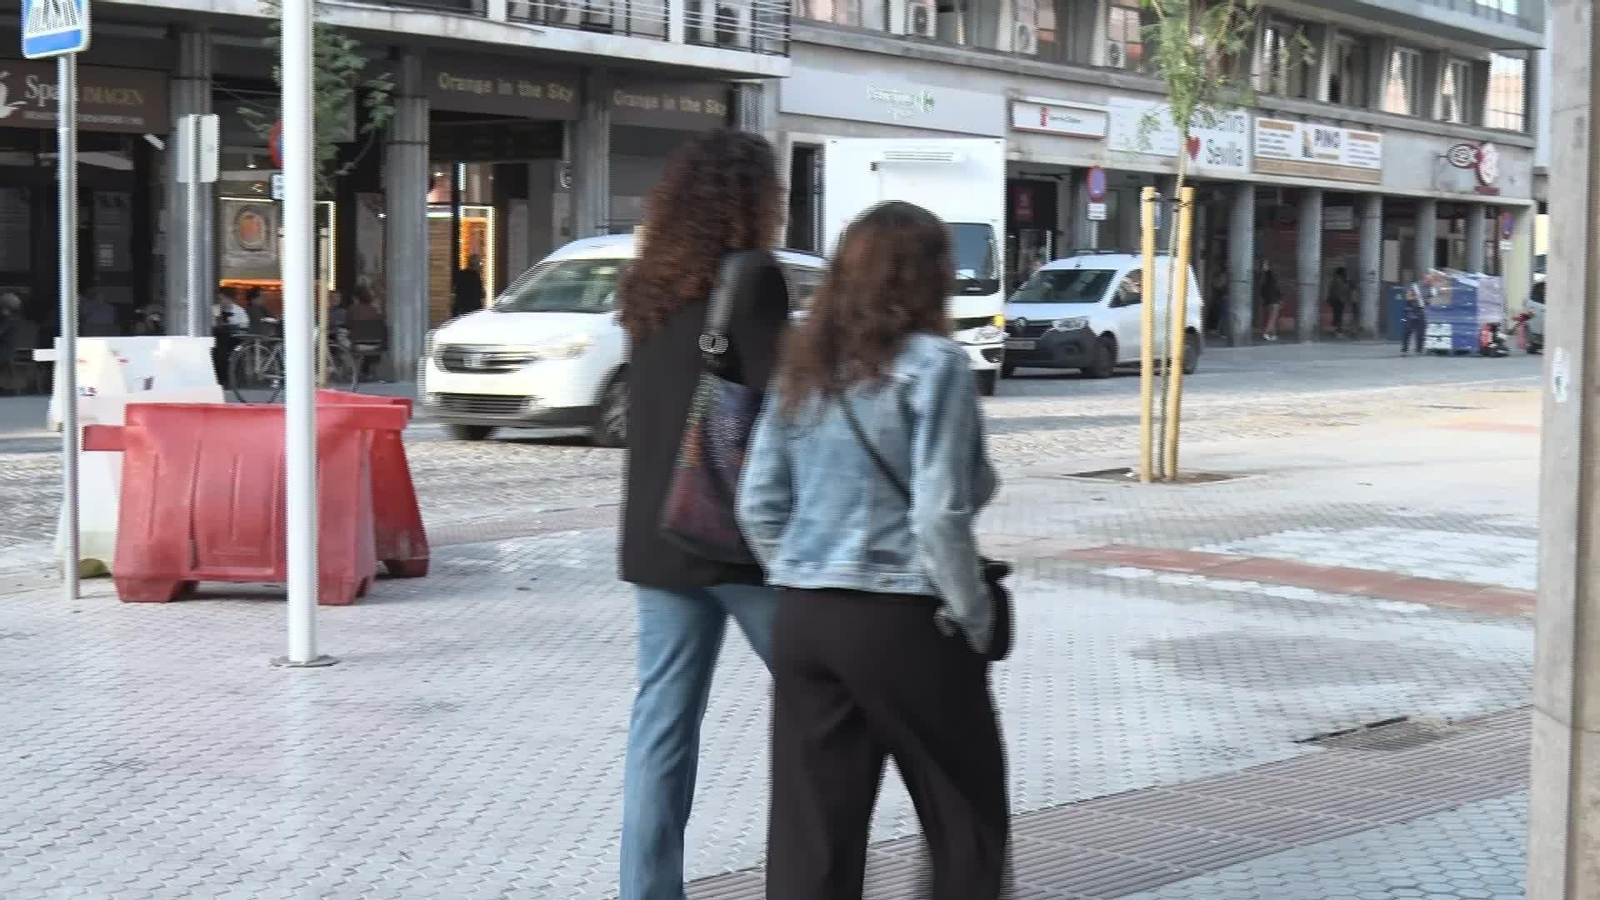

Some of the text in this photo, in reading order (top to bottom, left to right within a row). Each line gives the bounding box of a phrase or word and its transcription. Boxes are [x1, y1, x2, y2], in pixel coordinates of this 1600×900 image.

[25, 74, 80, 107] Spa
[438, 72, 573, 103] Orange in the Sky
[613, 89, 727, 116] Orange in the Sky
[1206, 138, 1243, 167] Sevilla
